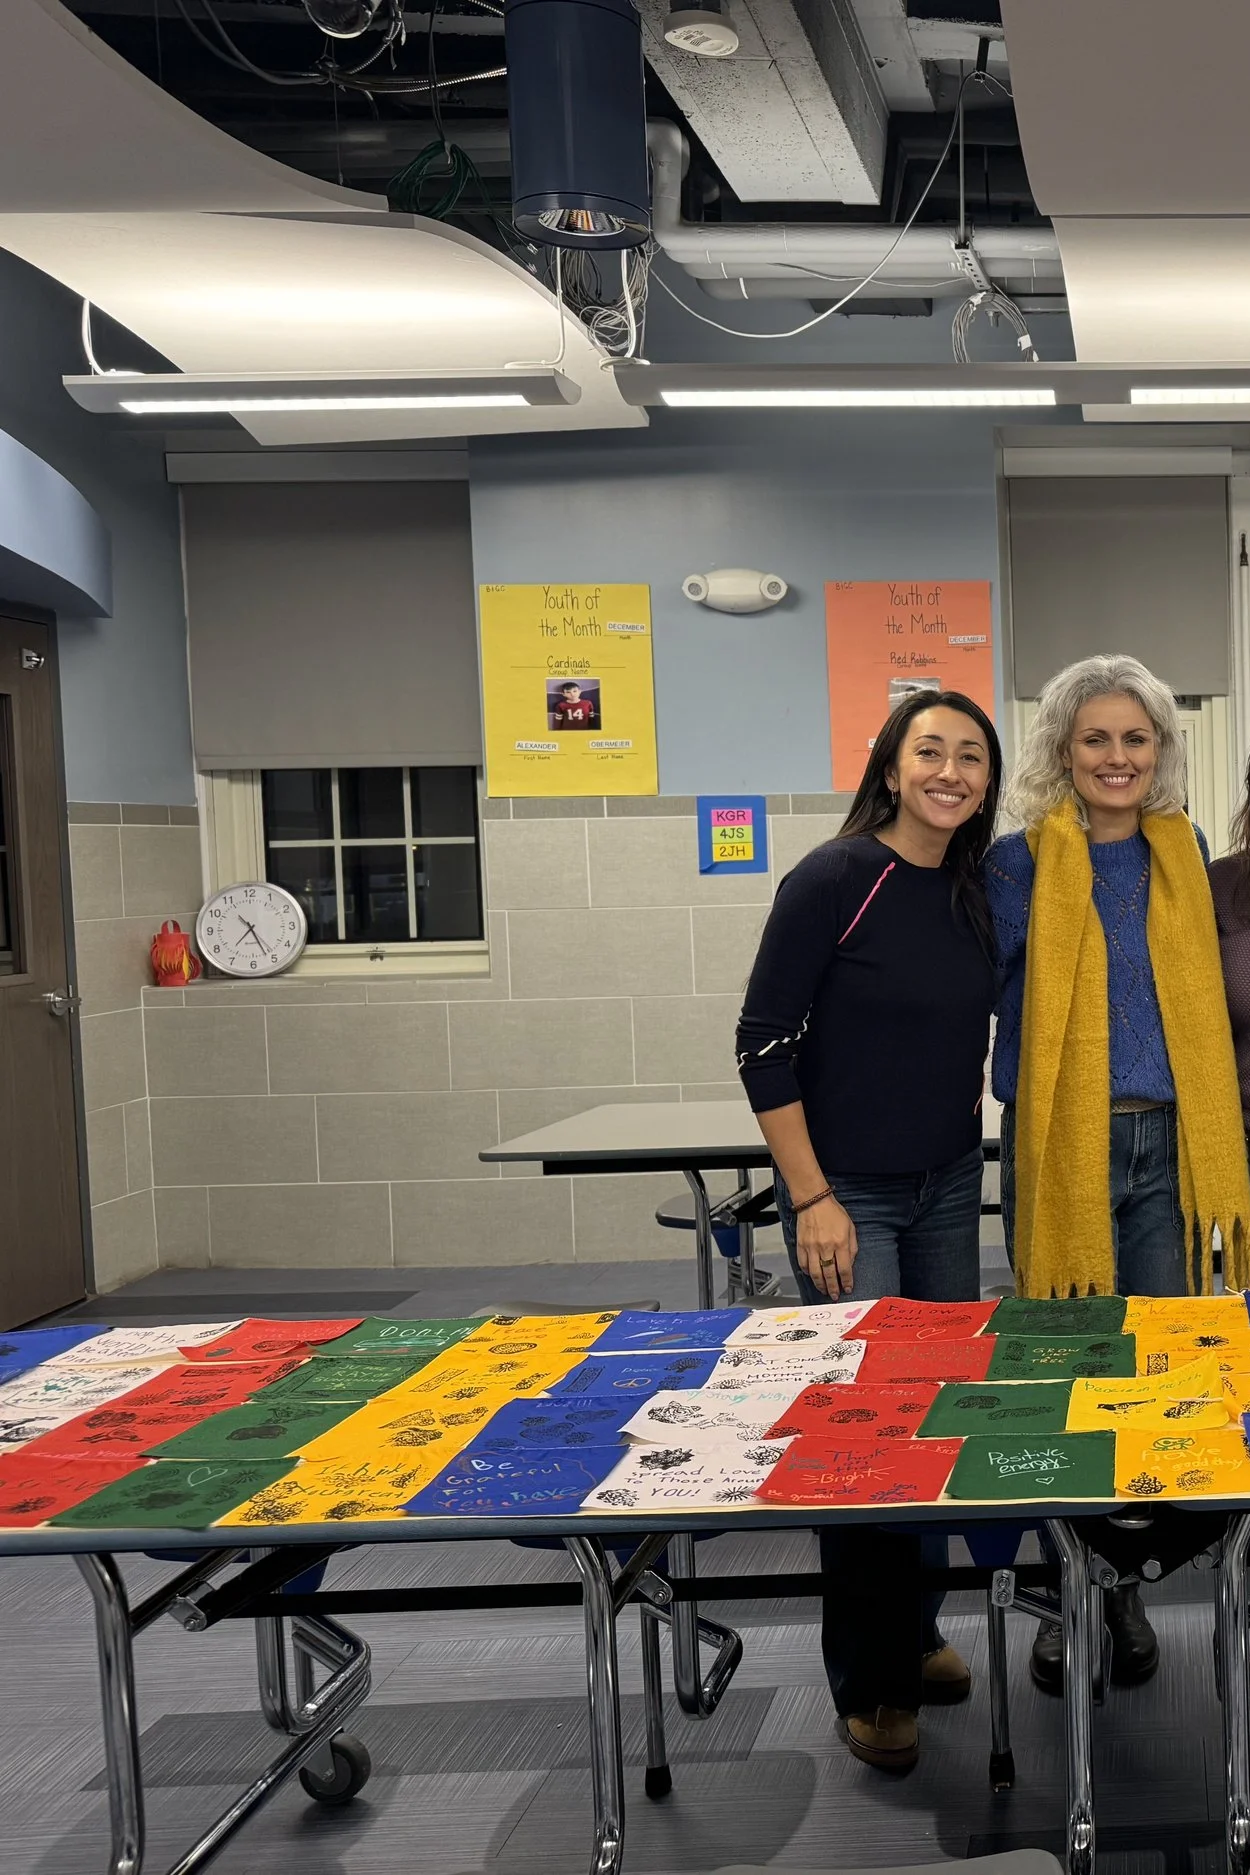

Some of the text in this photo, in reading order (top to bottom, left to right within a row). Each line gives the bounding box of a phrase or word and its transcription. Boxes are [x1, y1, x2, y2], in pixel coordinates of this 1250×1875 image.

[543, 586, 601, 610] Youth of
[887, 584, 942, 606] Youth of
[538, 616, 601, 637] the Month
[608, 623, 645, 632] DECEMBER
[885, 613, 948, 634] the Month
[949, 636, 986, 644] DECEMBER
[546, 655, 591, 669] Cardinals
[890, 652, 907, 664] Red
[567, 708, 584, 721] 14
[516, 742, 557, 750] ALEXANDER
[717, 810, 746, 821] KGR
[720, 827, 745, 839] 4JS
[720, 845, 746, 856] 2JH
[244, 889, 256, 897] 12
[267, 893, 272, 901] 1
[223, 896, 233, 905] 11
[209, 909, 221, 917] 10
[283, 904, 290, 913] 2
[289, 921, 295, 930] 3
[207, 927, 214, 935] 9
[284, 940, 291, 948] 4
[213, 945, 220, 954] 8
[229, 957, 235, 966] 7
[271, 955, 278, 963] 5
[250, 961, 257, 969] 6
[888, 1304, 957, 1315] Follow
[1141, 1447, 1222, 1462] have
[471, 1459, 515, 1471] Be
[1172, 1460, 1209, 1470] good
[446, 1463, 562, 1485] Grateful
[820, 1467, 882, 1486] Bright
[511, 1486, 581, 1500] have
[651, 1488, 701, 1498] YOU!
